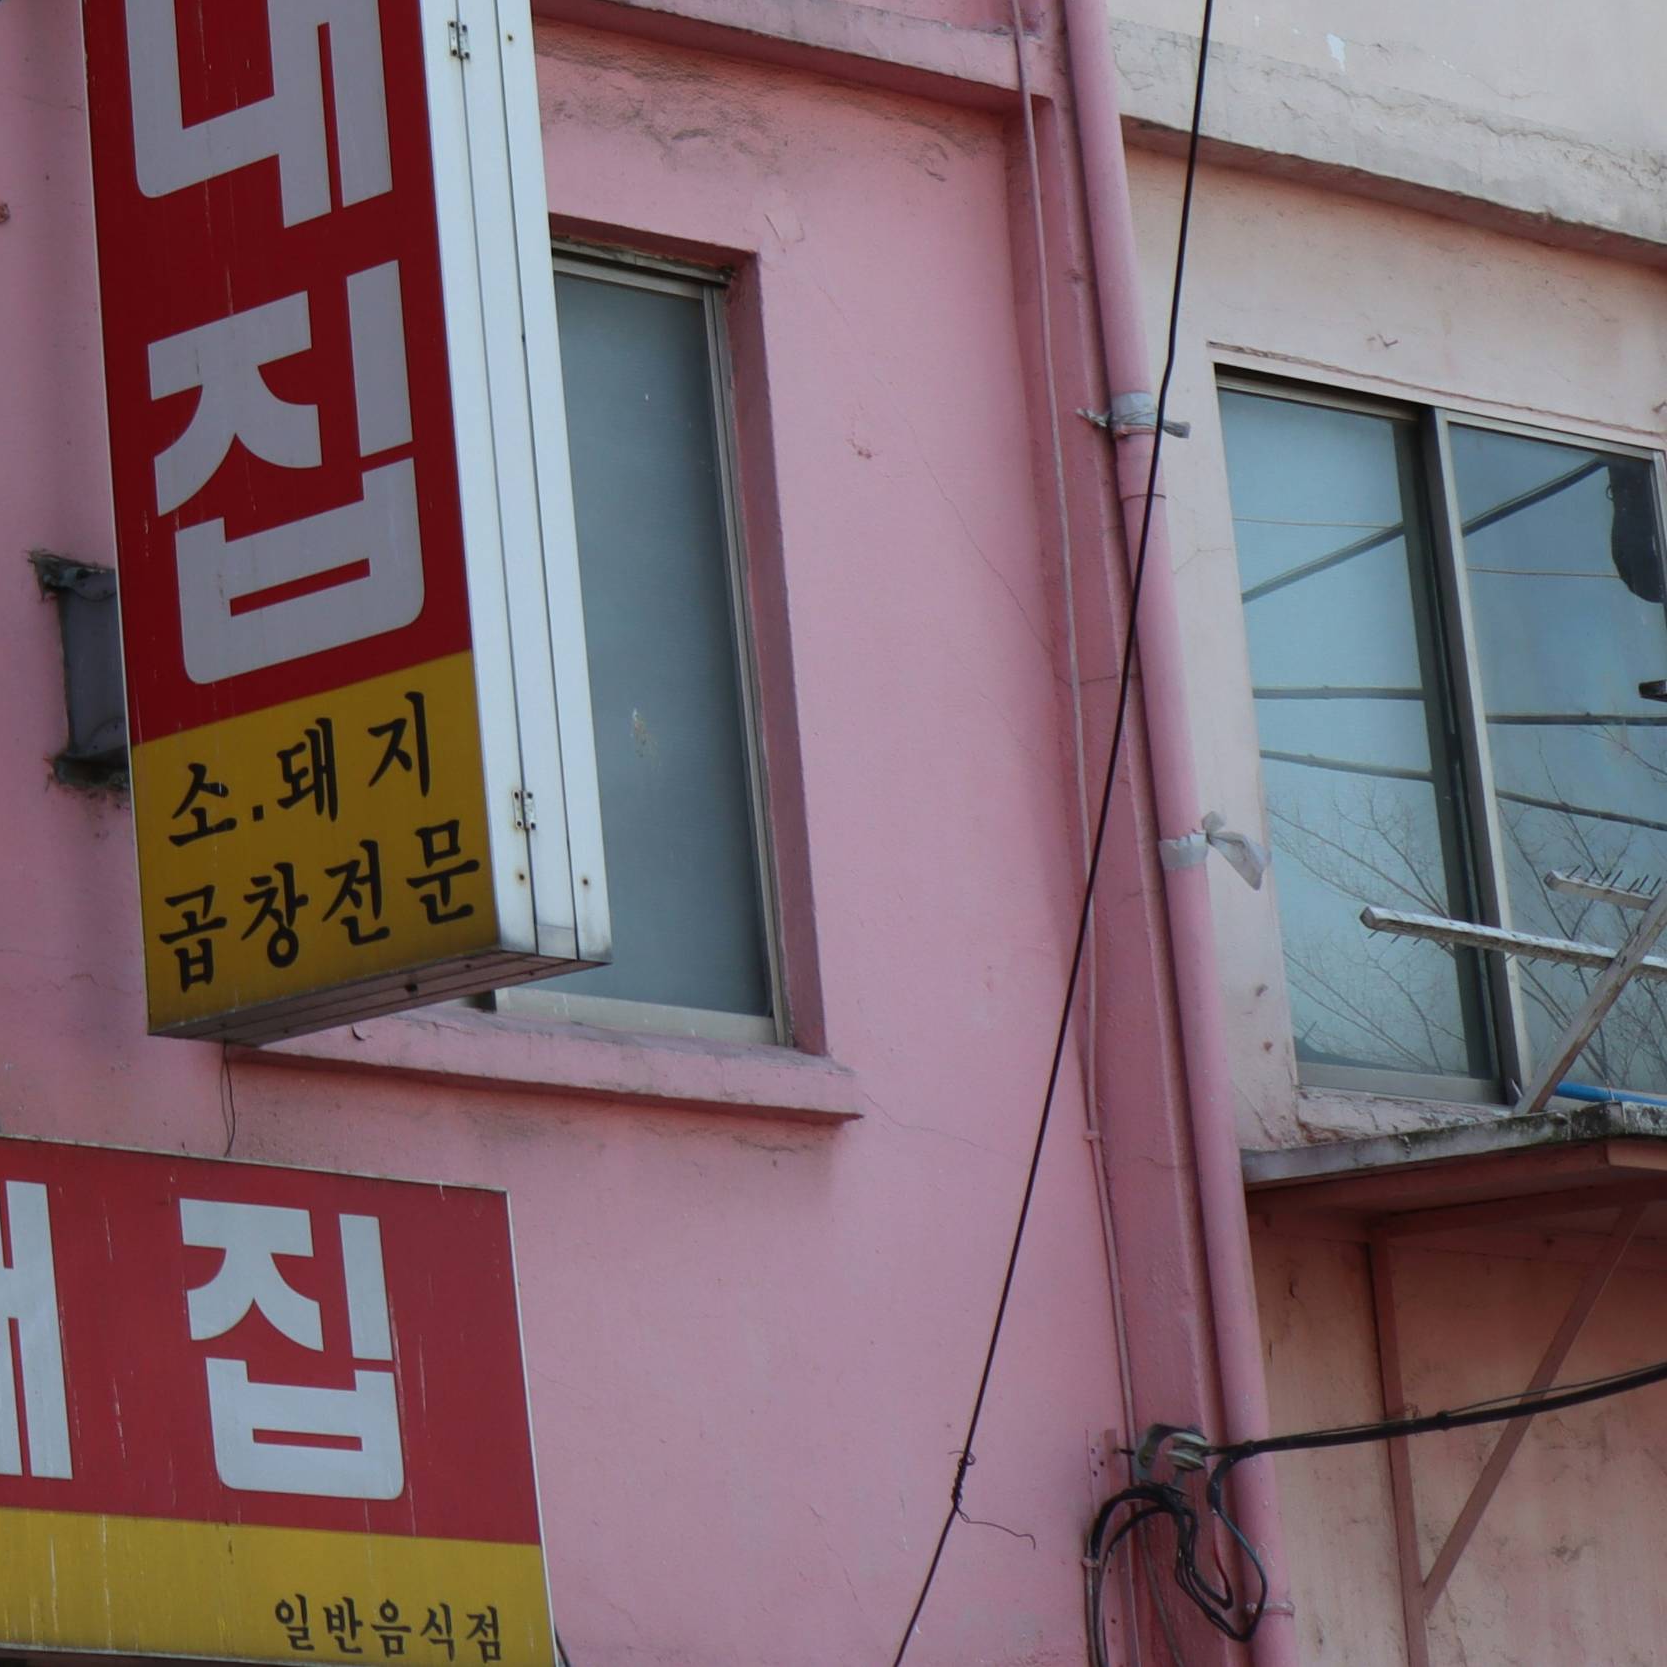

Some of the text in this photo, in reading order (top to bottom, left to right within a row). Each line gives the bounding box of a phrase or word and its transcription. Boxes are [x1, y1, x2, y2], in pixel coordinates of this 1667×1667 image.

[167, 690, 432, 848] 소.돼지
[159, 819, 481, 992] 곱창전문
[274, 1593, 502, 1664] 일반음식점
